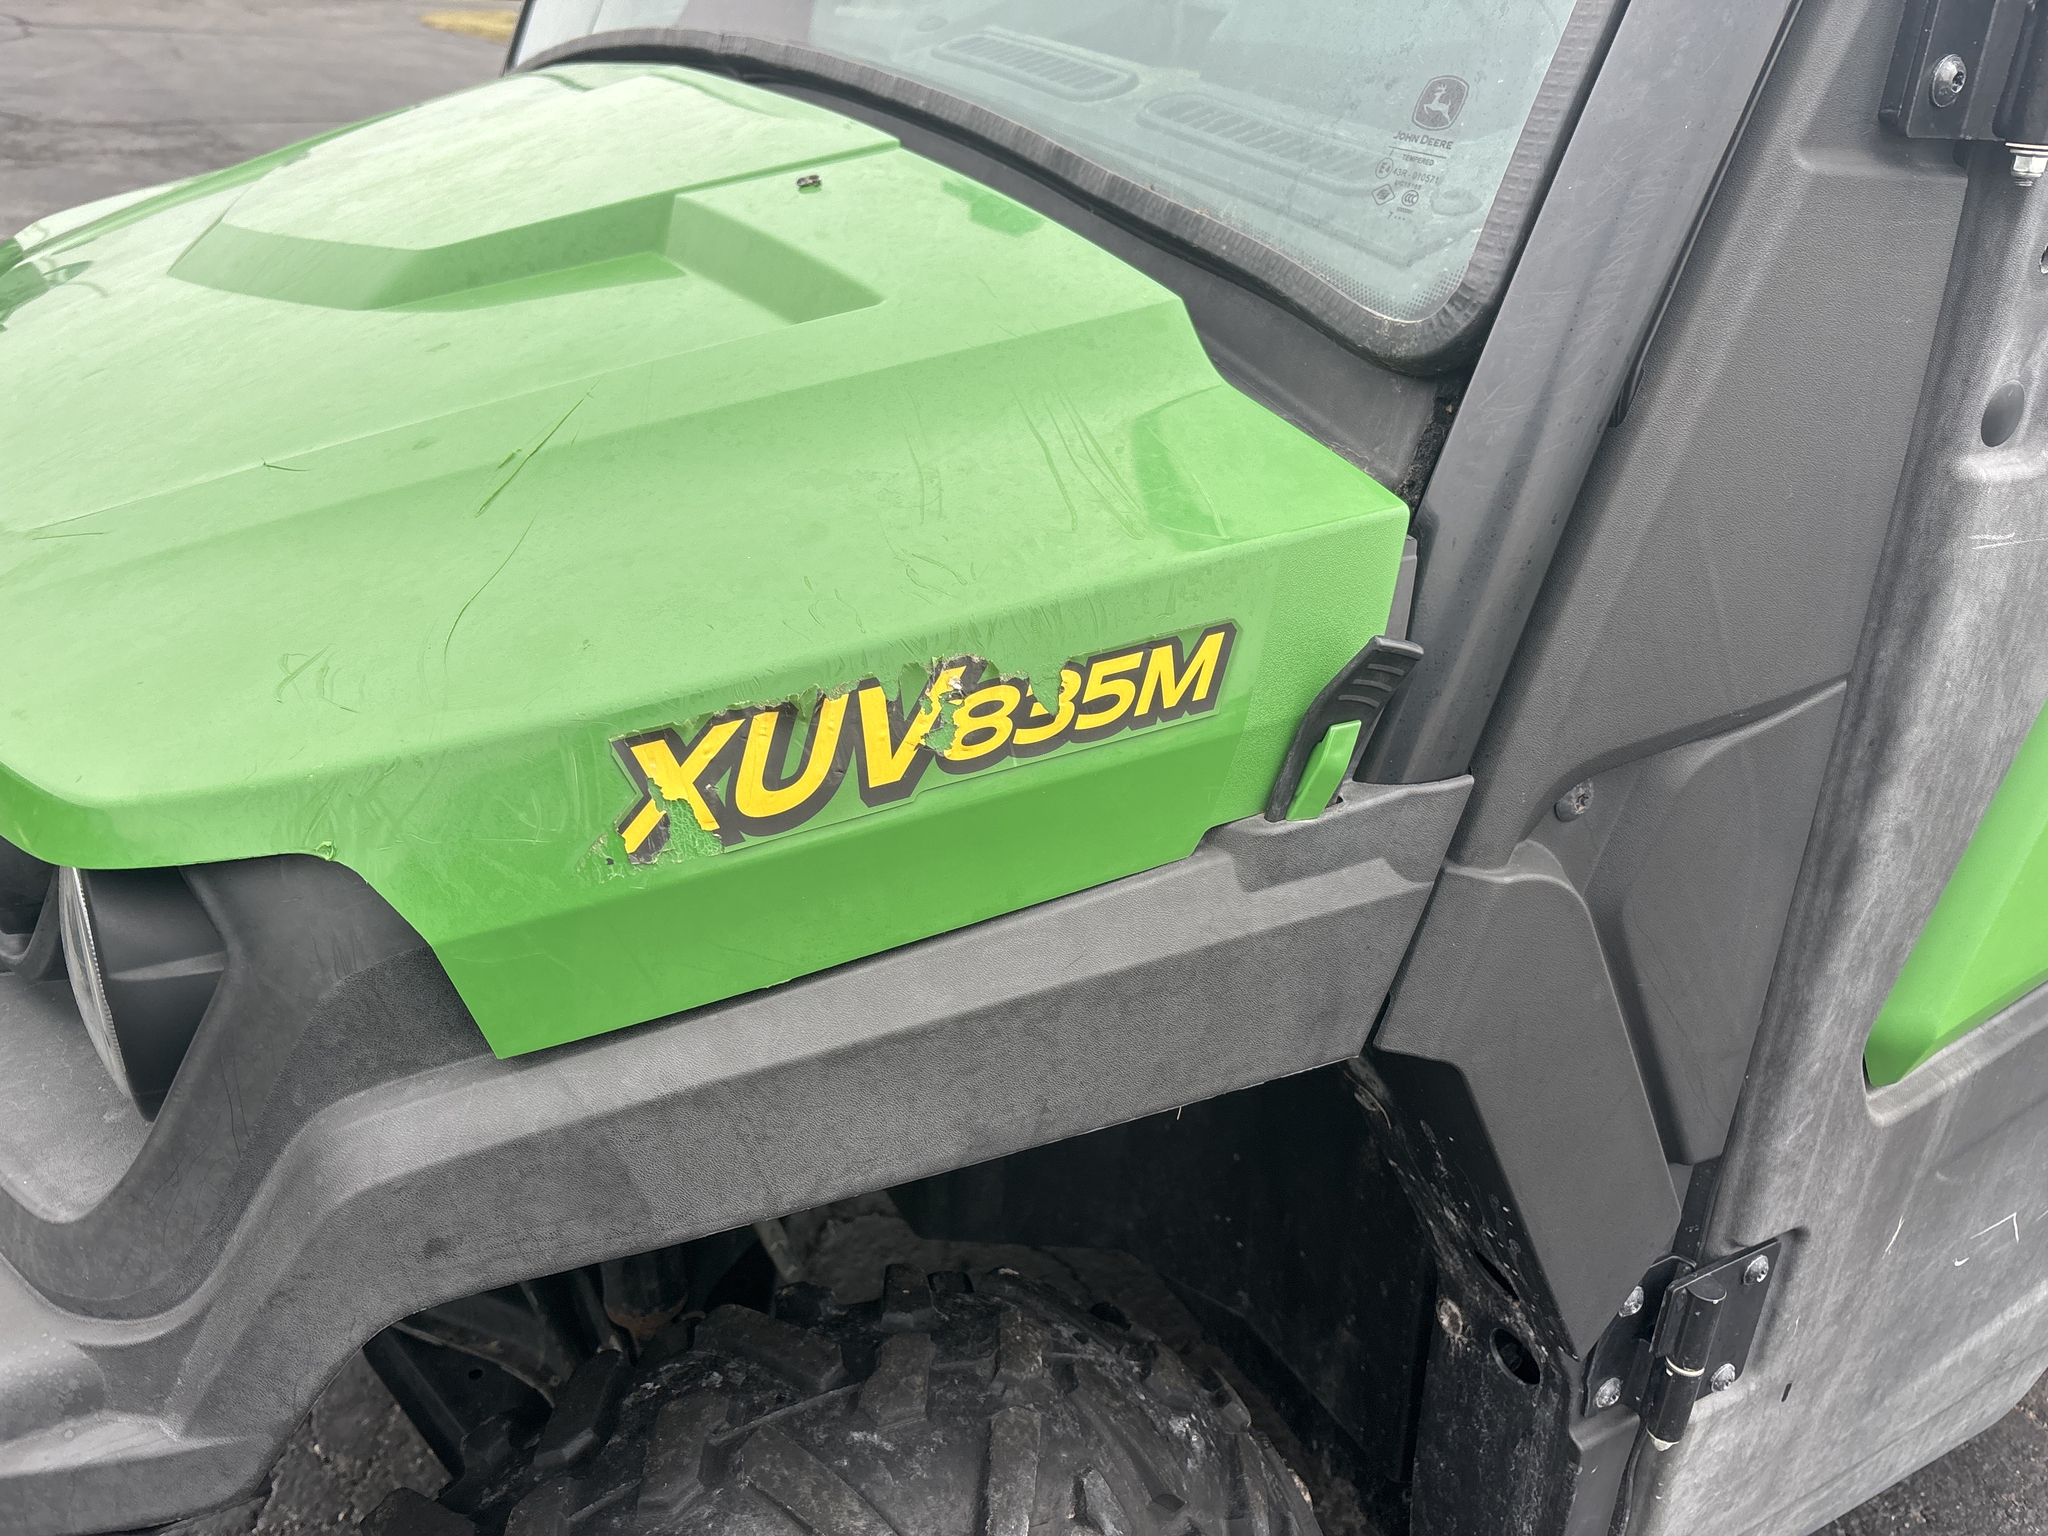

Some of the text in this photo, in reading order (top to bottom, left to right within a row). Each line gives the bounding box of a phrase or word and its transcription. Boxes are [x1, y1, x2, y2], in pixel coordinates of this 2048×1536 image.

[1393, 130, 1454, 150] JOHN DEERE
[1402, 154, 1435, 166] TEMPERED
